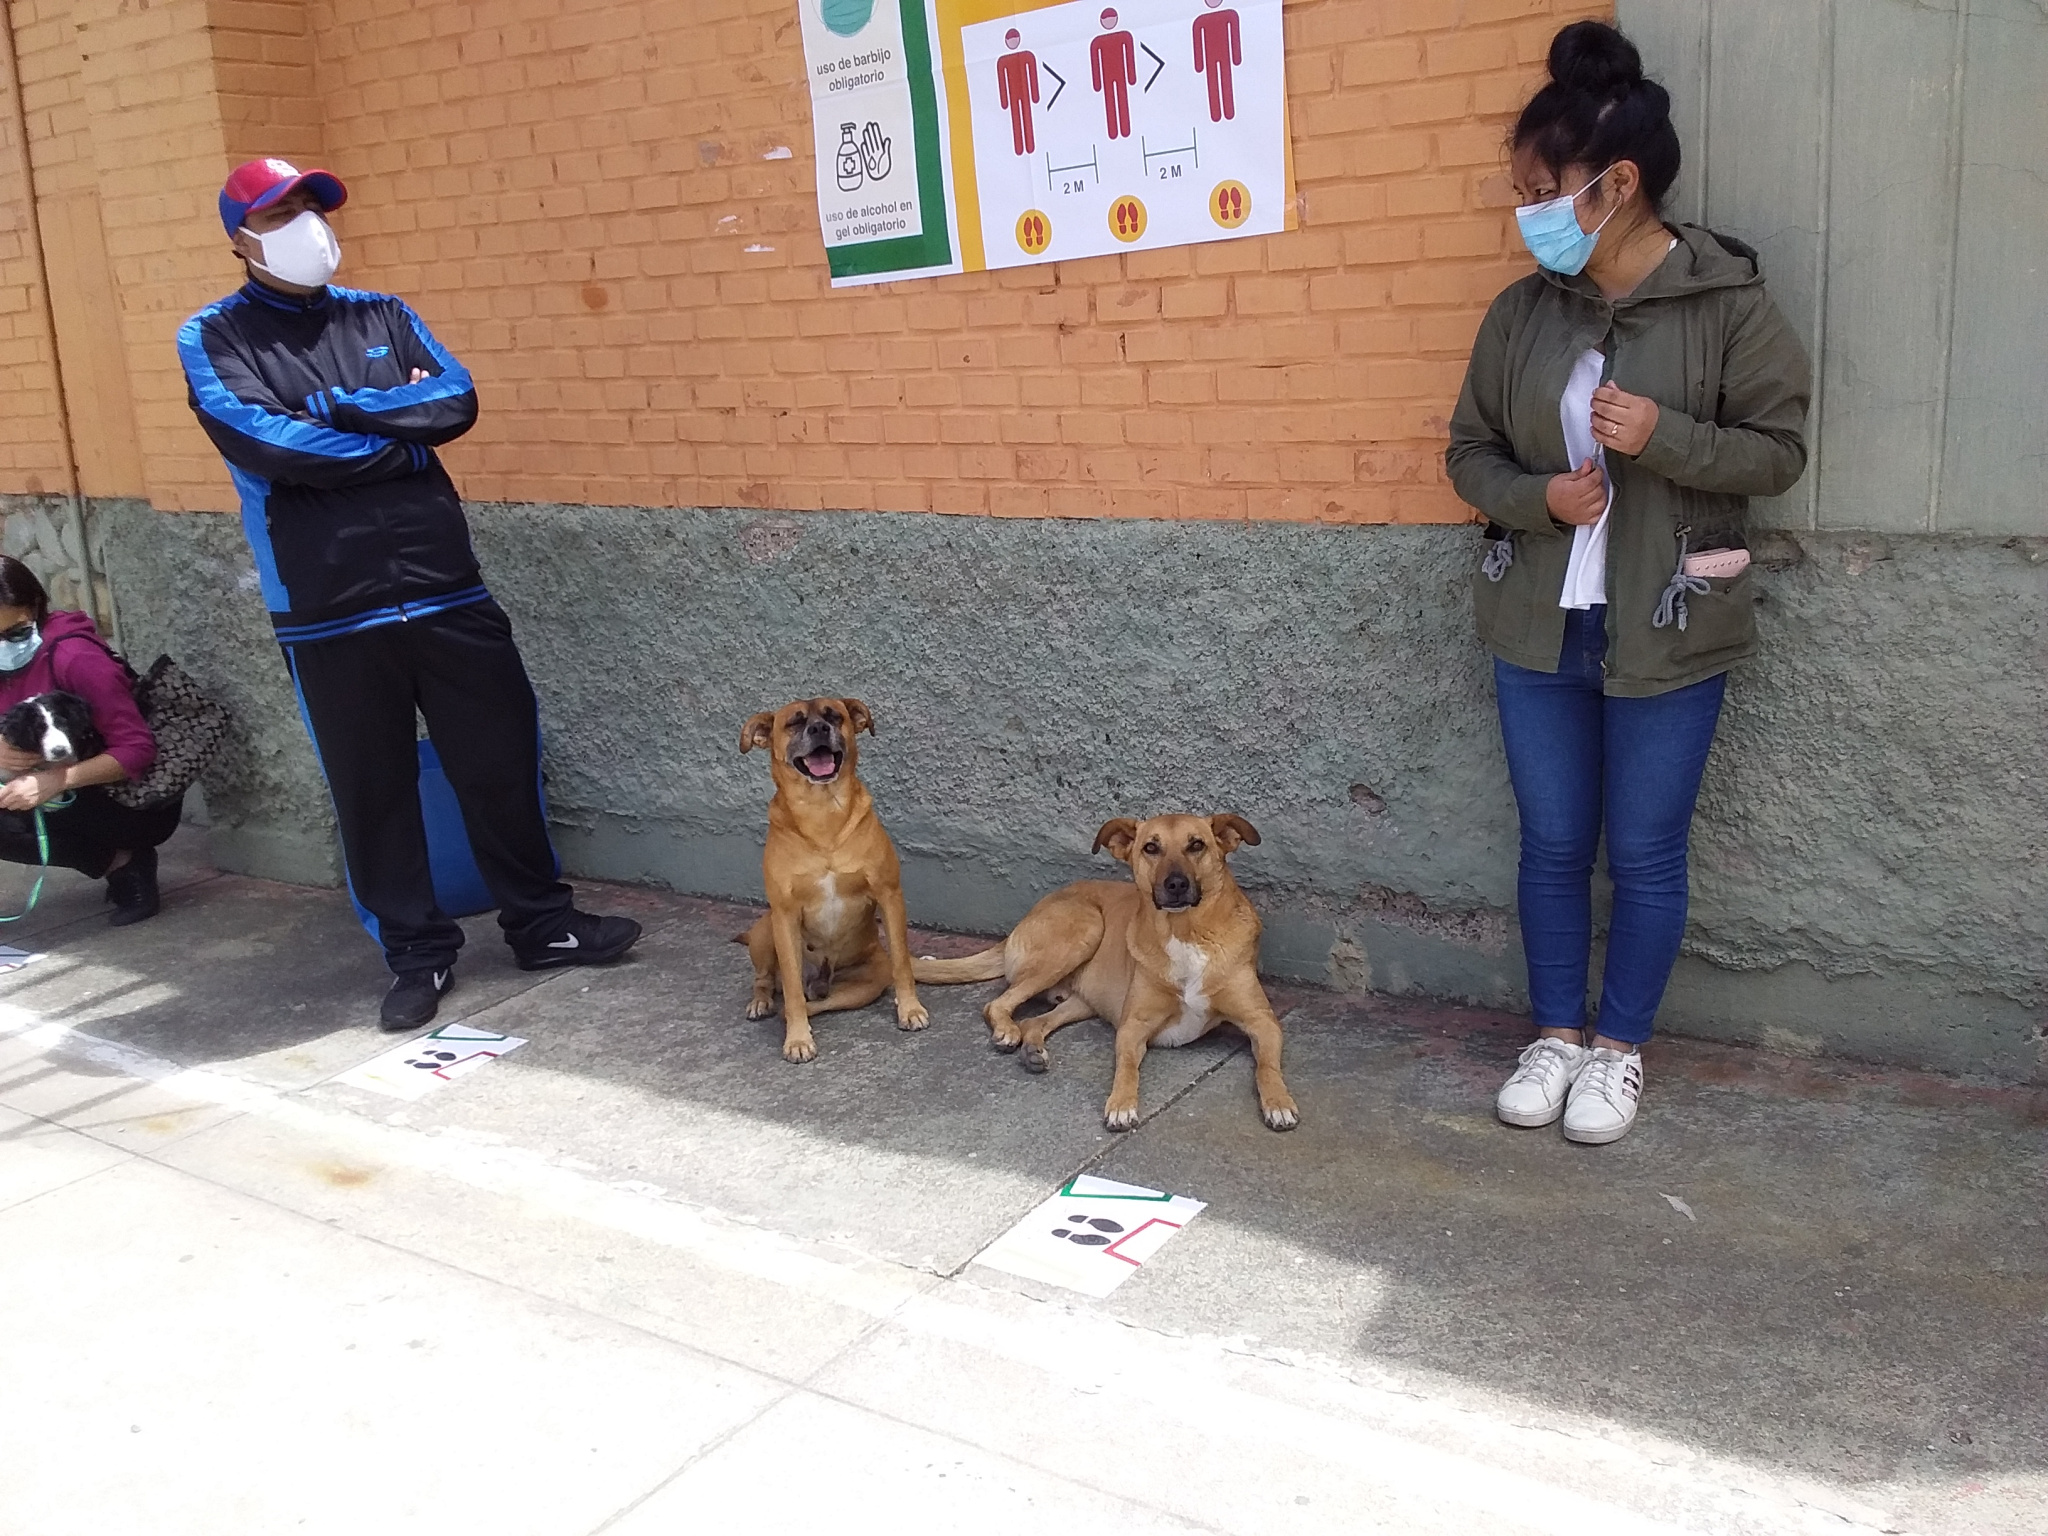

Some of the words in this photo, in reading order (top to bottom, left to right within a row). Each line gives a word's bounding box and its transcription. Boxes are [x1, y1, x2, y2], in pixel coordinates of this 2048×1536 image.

[816, 62, 836, 75] uso
[838, 57, 852, 70] de
[853, 48, 891, 67] barbijo
[829, 69, 885, 91] obligatorio
[1159, 167, 1168, 179] 2
[1171, 164, 1182, 178] M
[1063, 182, 1071, 195] 2
[1073, 180, 1084, 193] M
[826, 211, 844, 222] uso
[846, 207, 859, 220] de
[860, 201, 897, 218] alcohol
[900, 201, 913, 211] en
[835, 225, 850, 240] gel
[852, 218, 906, 236] obligatorio
